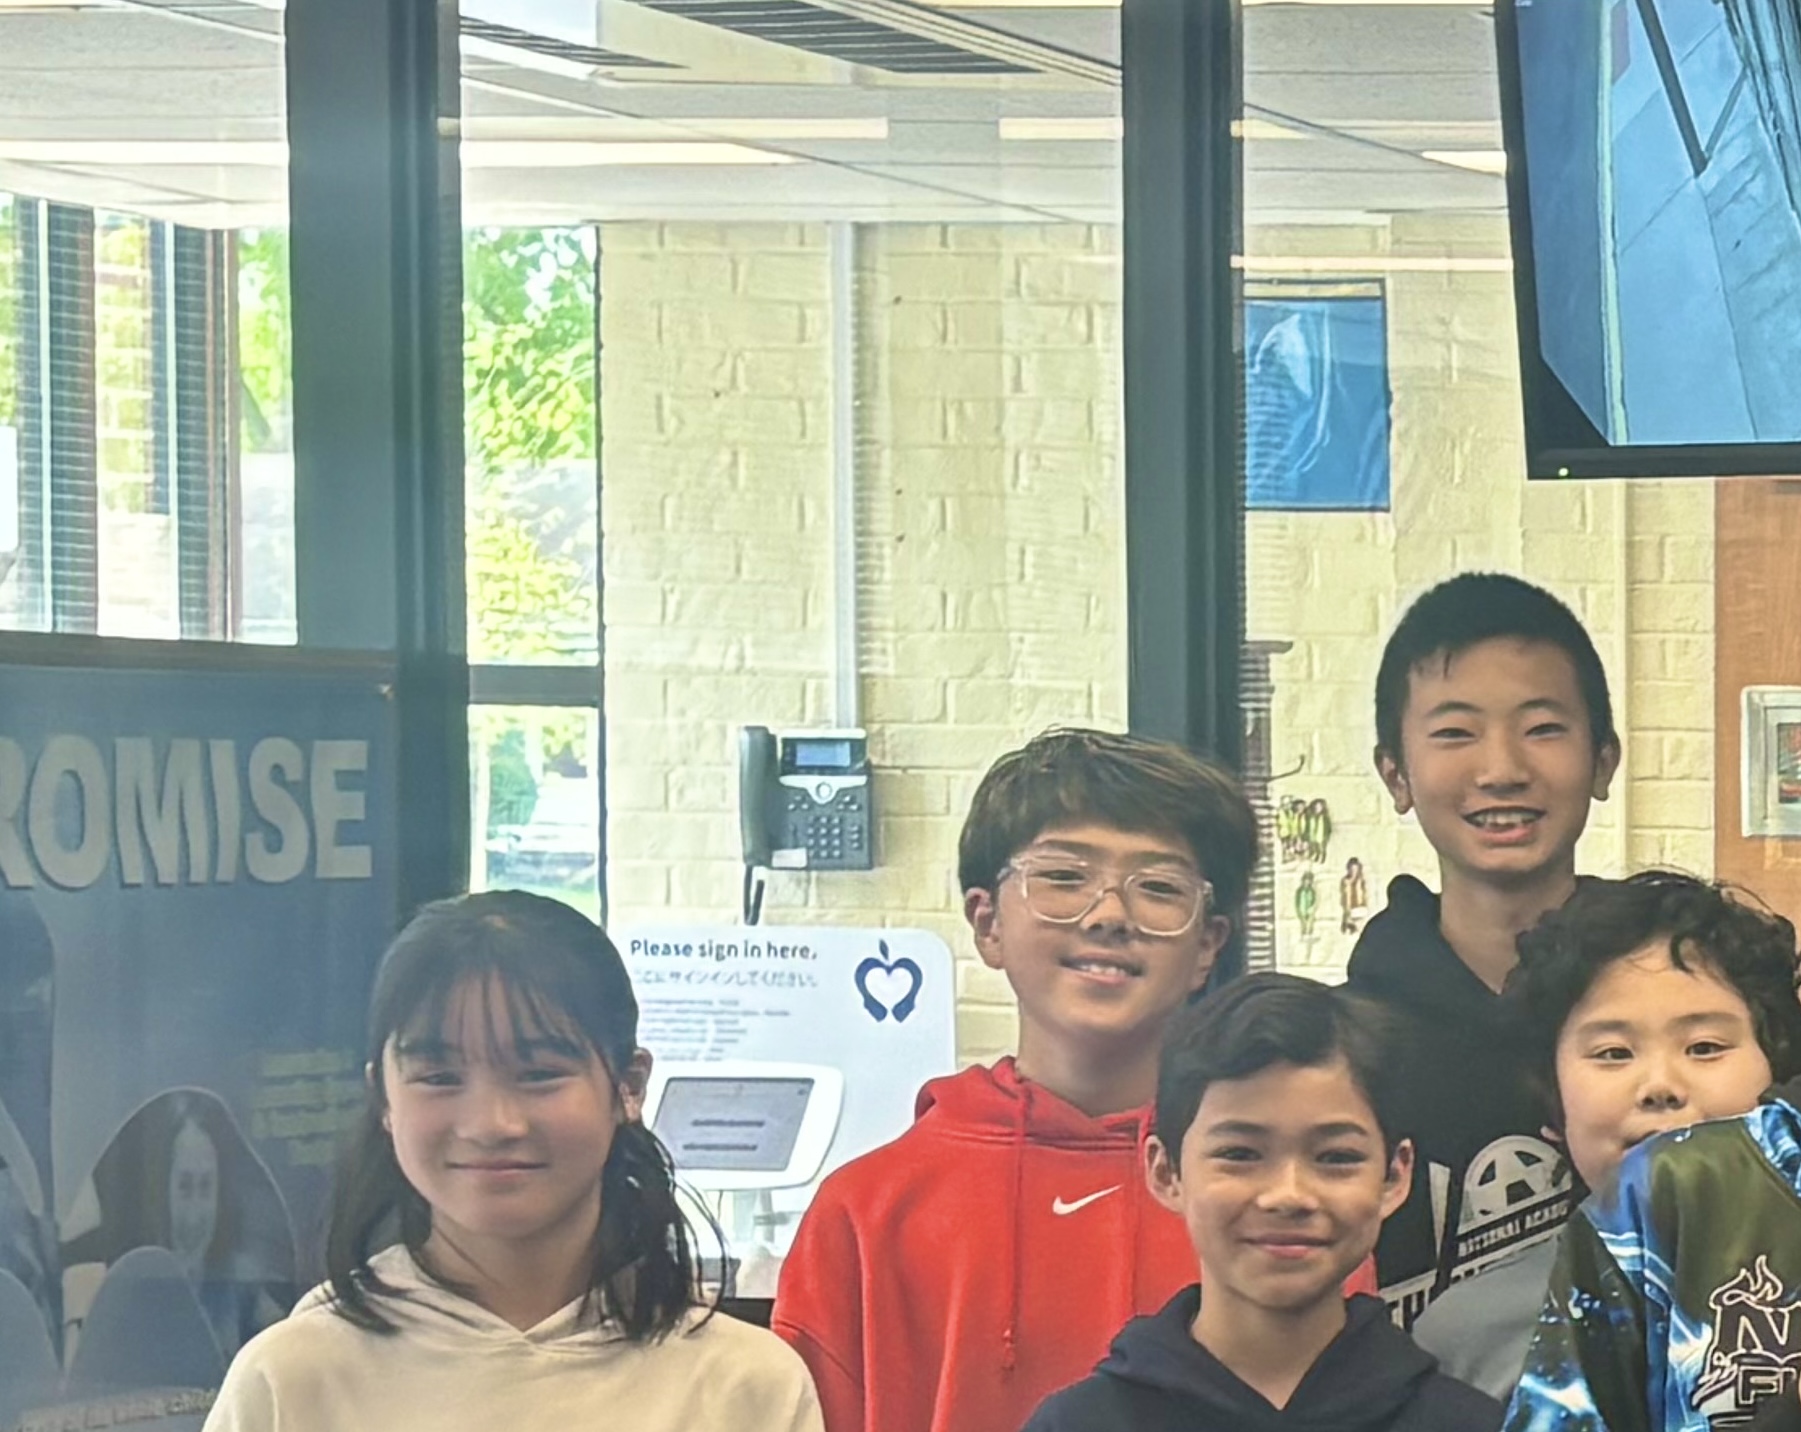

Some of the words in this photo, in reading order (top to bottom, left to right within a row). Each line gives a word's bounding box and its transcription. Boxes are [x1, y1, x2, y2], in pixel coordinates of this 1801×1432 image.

[631, 939, 693, 957] Please
[698, 939, 738, 962] sign
[744, 940, 761, 958] in
